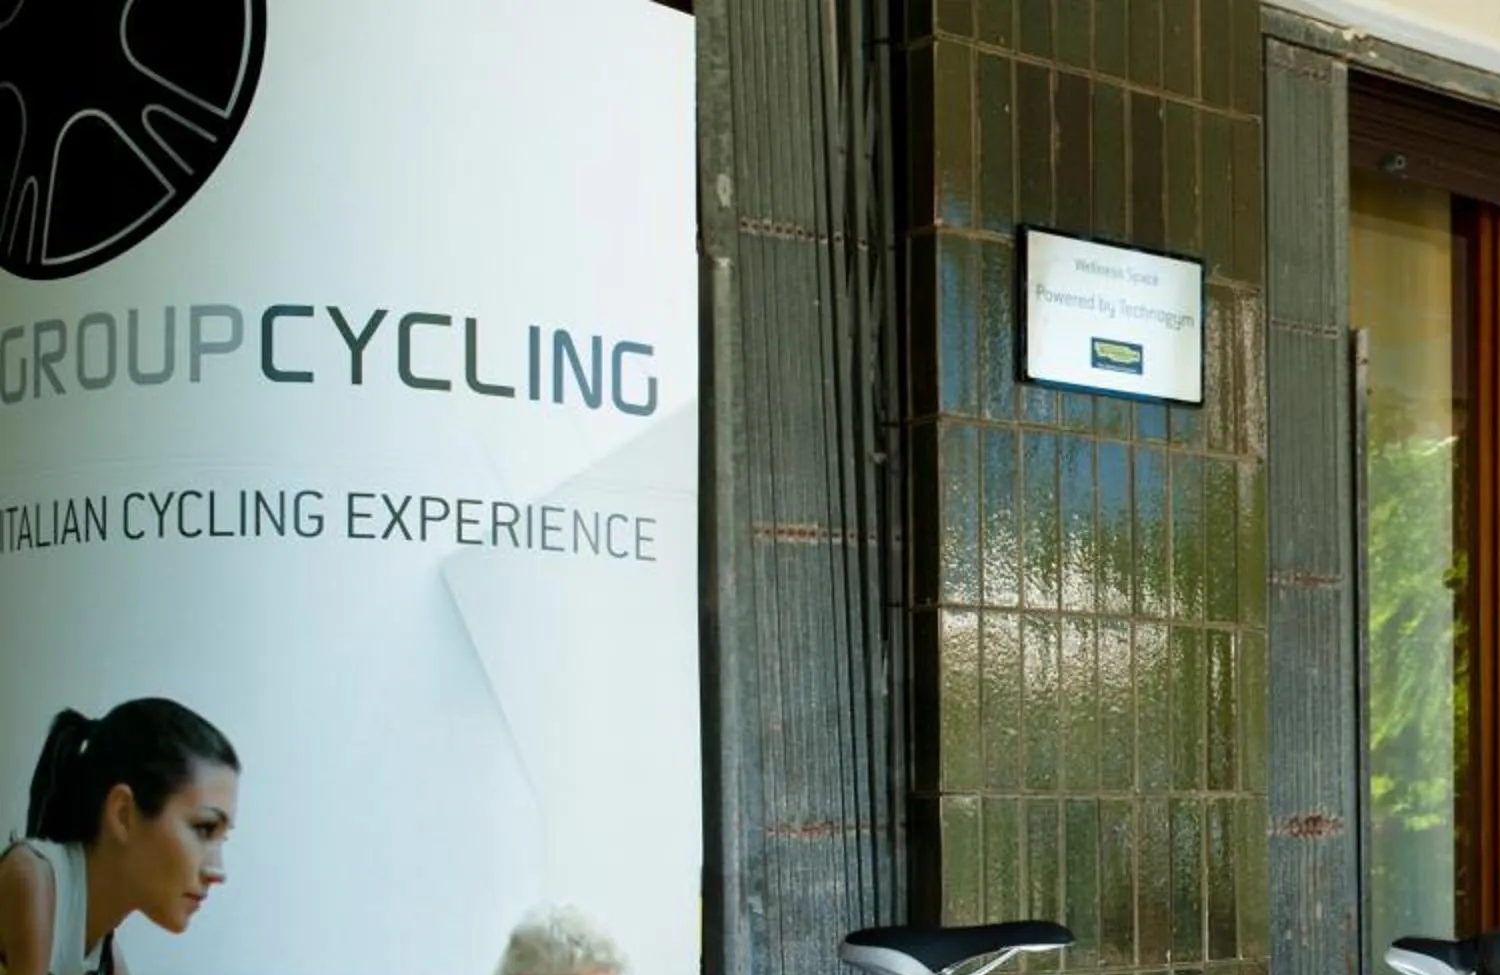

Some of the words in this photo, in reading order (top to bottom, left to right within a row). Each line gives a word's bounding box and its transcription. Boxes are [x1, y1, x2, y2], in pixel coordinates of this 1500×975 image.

[1035, 282, 1096, 312] Powered
[1098, 296, 1116, 319] by
[1118, 298, 1196, 332] Technogym
[0, 495, 107, 552] ITALIAN
[122, 489, 325, 541] CYCLING
[346, 492, 658, 562] EXPERIENCE
